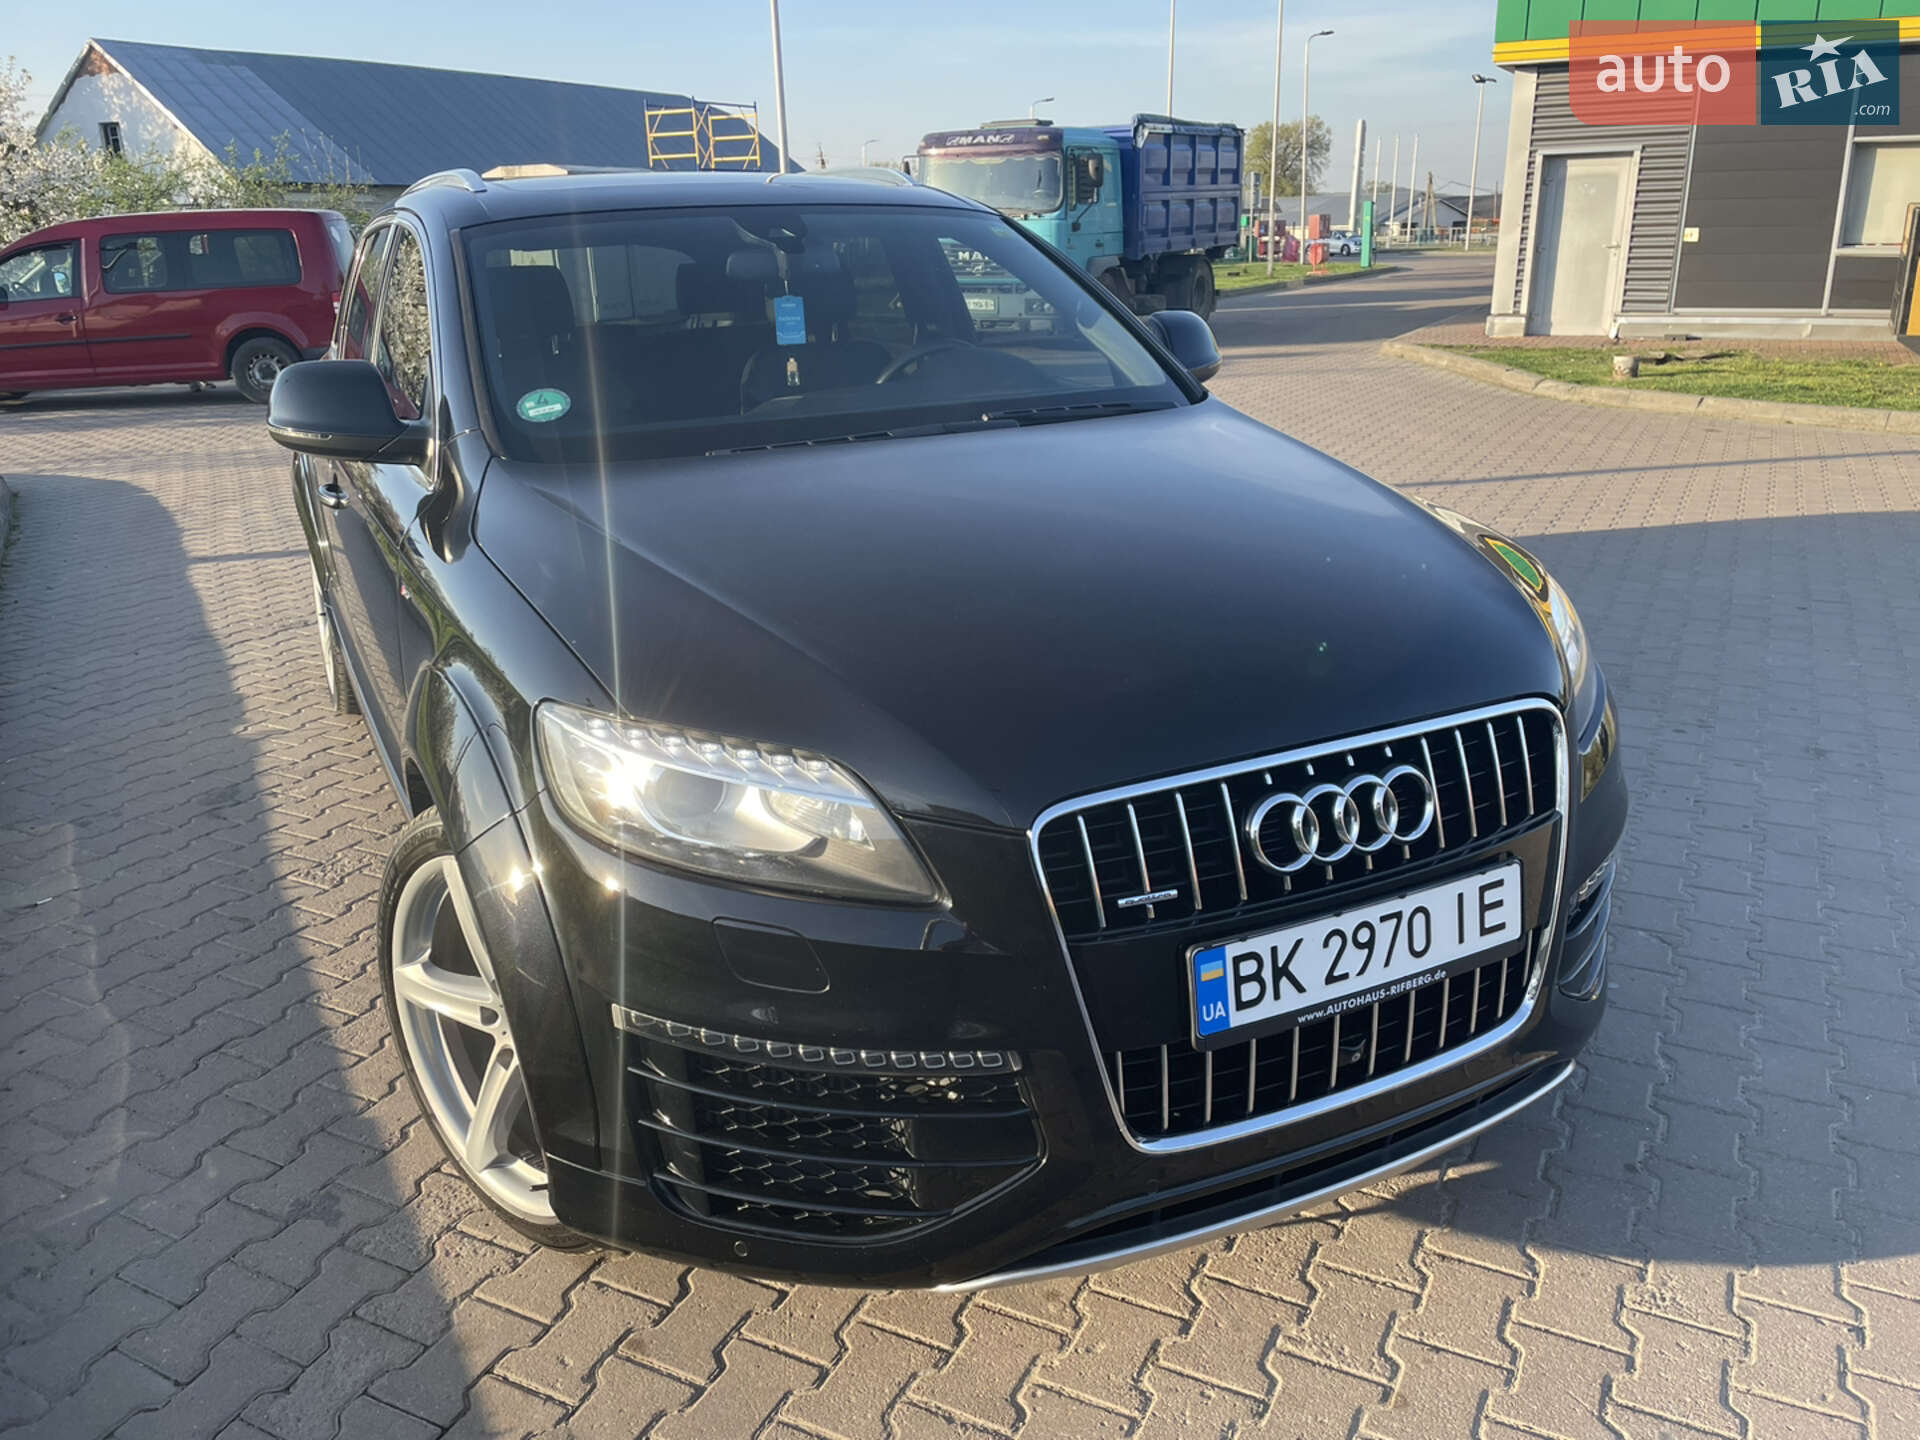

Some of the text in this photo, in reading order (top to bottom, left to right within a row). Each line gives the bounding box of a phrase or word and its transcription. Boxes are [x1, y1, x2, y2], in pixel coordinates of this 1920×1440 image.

[959, 134, 1000, 145] MAN
[1232, 878, 1507, 1012] BK 2970 IE
[1202, 1001, 1227, 1023] UA
[1297, 969, 1448, 1024] www.AUTOHAUS-RIFBERG.de
